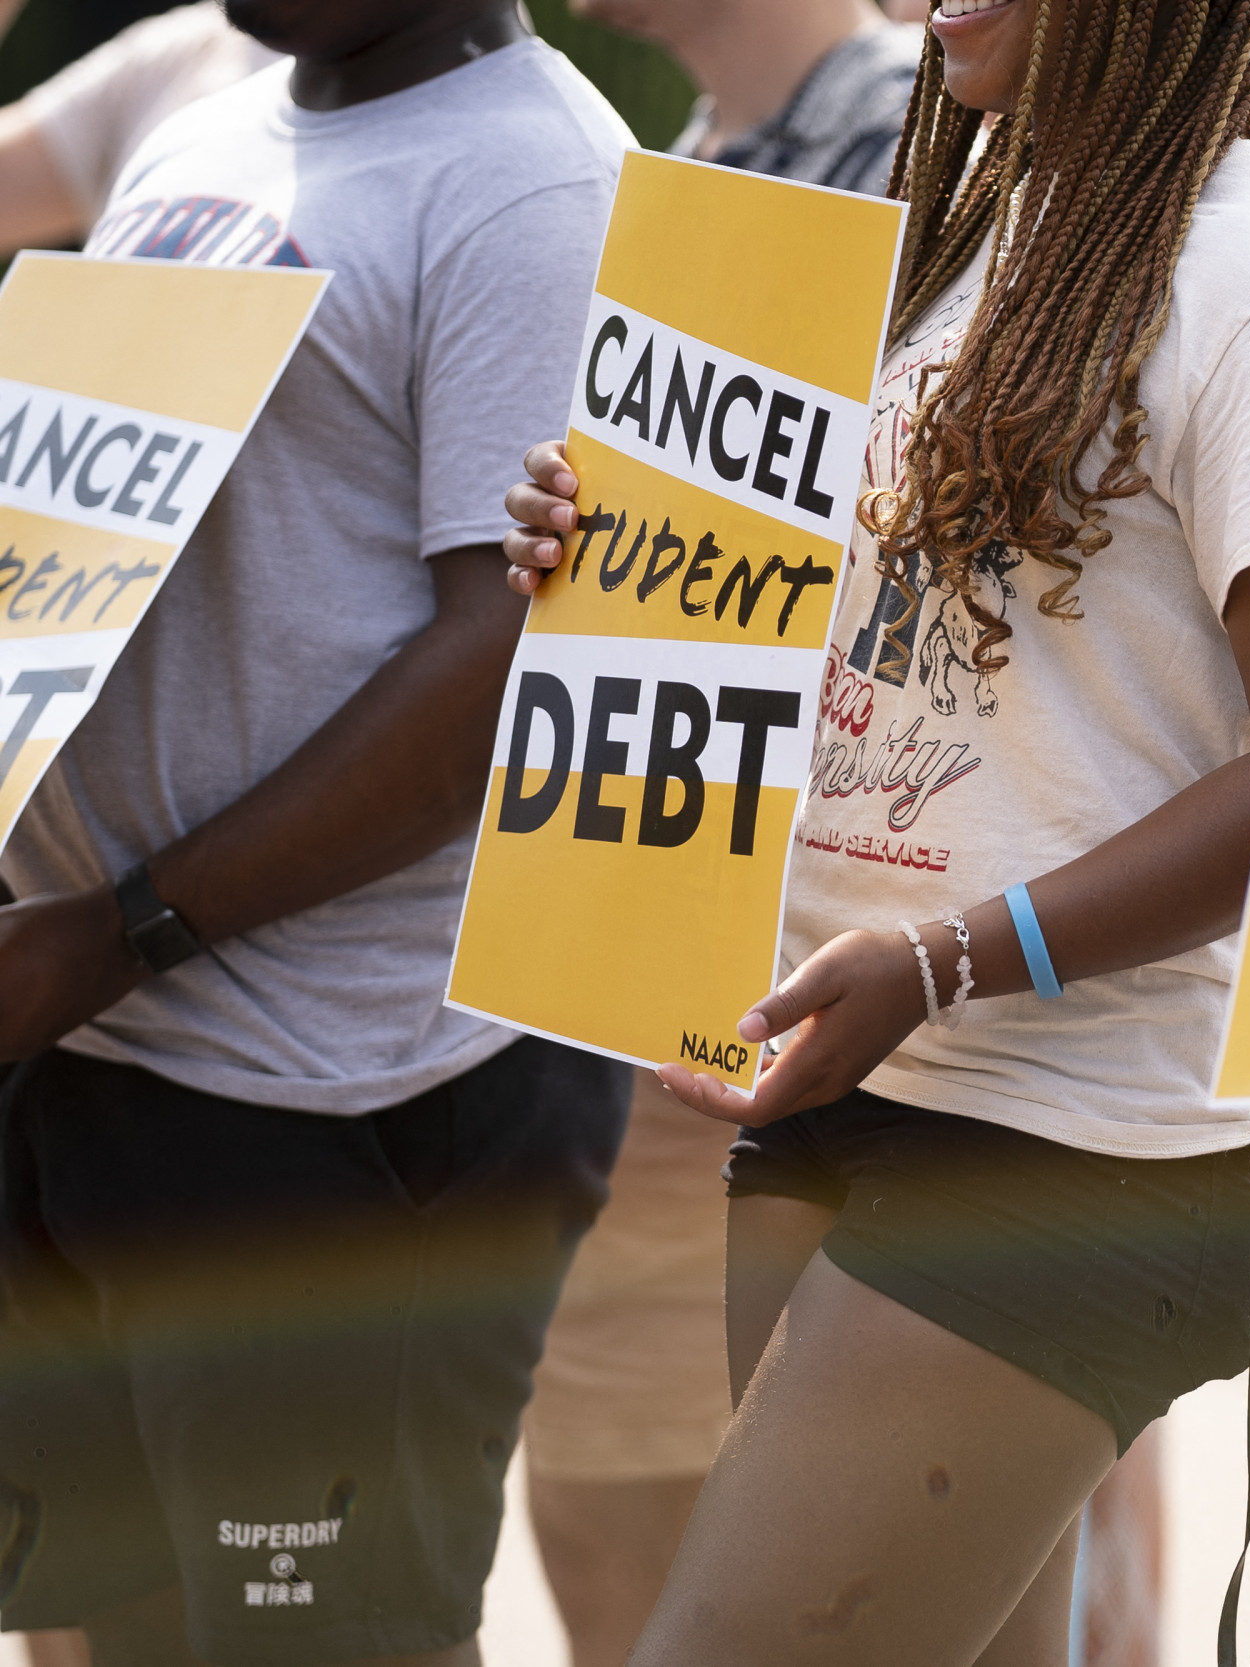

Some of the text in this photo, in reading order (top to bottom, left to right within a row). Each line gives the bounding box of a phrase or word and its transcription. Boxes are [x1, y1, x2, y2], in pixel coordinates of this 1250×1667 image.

[0, 398, 204, 526] ANCEL
[584, 315, 834, 519] CANCEL
[0, 543, 161, 623] DENT
[541, 503, 834, 637] TUDENT
[497, 670, 801, 857] DEBT
[806, 825, 844, 853] AND
[846, 834, 950, 872] SERVICE
[680, 1030, 748, 1074] NAACP
[218, 1517, 342, 1549] SUPERDRY
